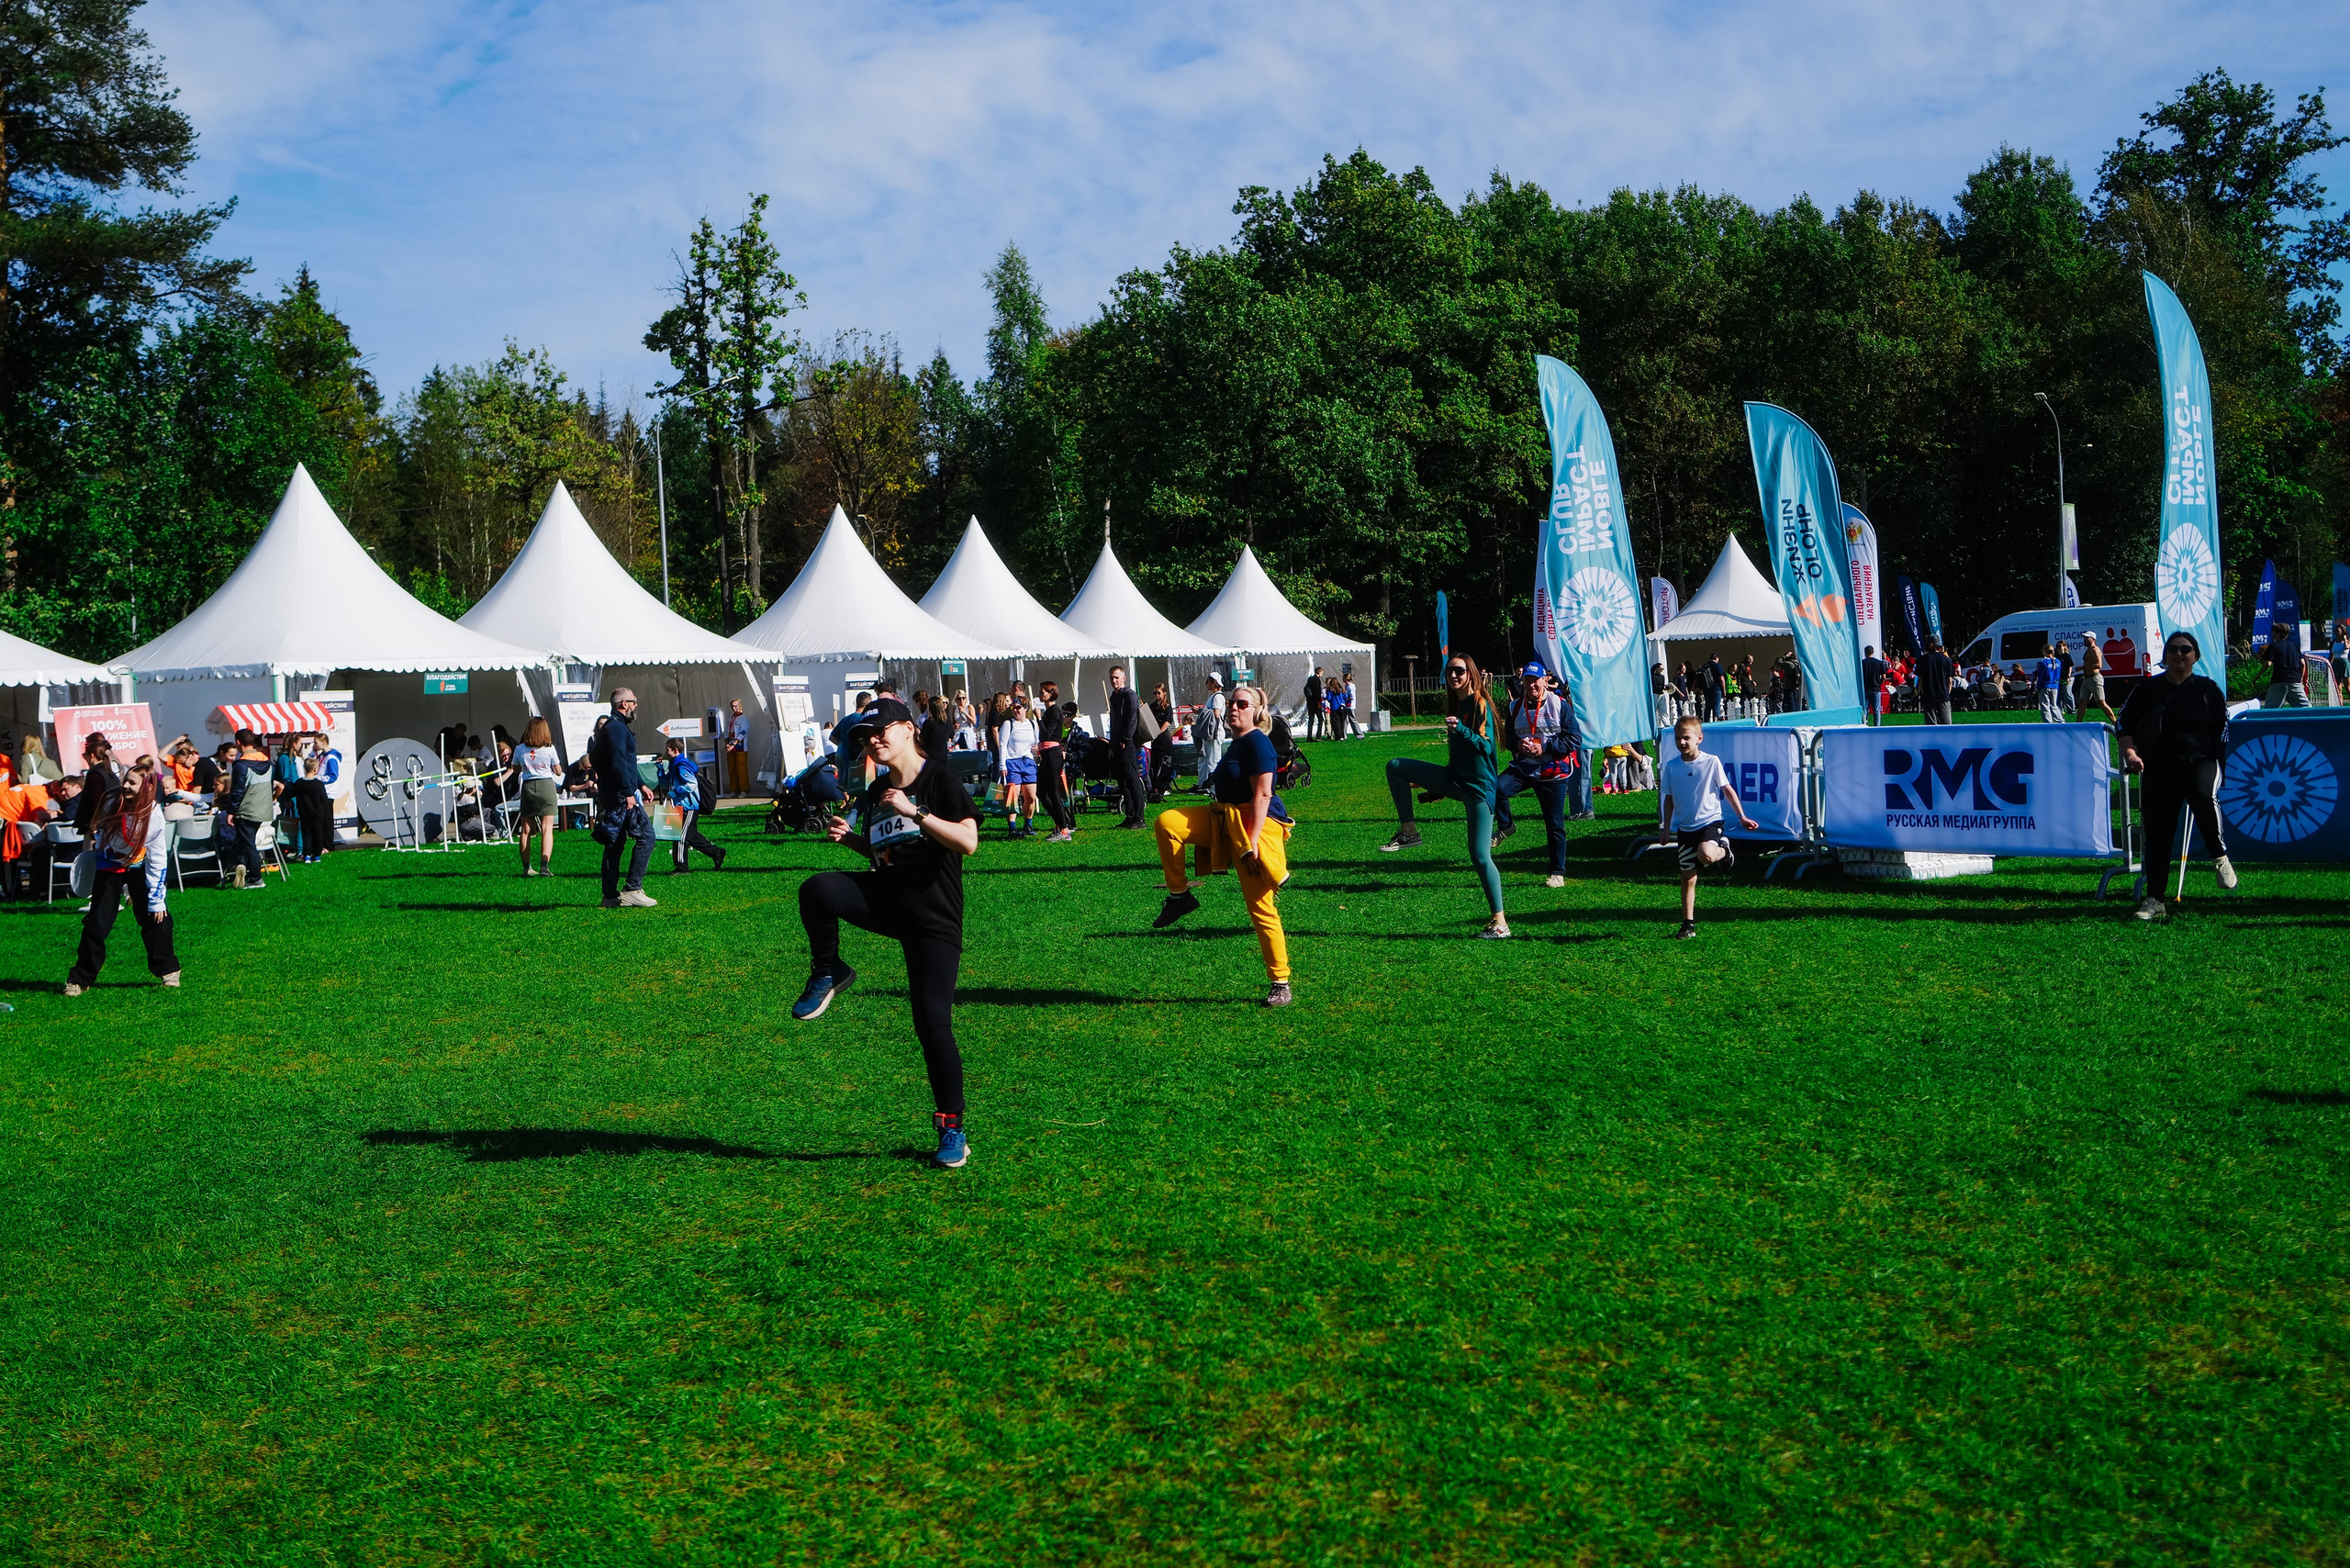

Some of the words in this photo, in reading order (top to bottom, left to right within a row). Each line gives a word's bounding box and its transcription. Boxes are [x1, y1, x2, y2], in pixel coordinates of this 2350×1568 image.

[1851, 560, 1864, 626] СПЕЦИАЛЬНОГО
[1863, 565, 1874, 620] НАЗНАЧЕНИЯ
[1538, 588, 1546, 633] МЕДИЦИНА
[426, 673, 467, 681] БЛАГОДЕЙСТВИЕ
[73, 730, 148, 743] ПОУЖЕНИЕ
[90, 719, 128, 731] 100%
[1719, 762, 1779, 803] AER
[1884, 748, 2035, 811] RMG
[878, 817, 905, 836] 104
[1886, 814, 1940, 828] РУССКАЯ
[1943, 814, 2036, 831] МЕДИАГРУППА
